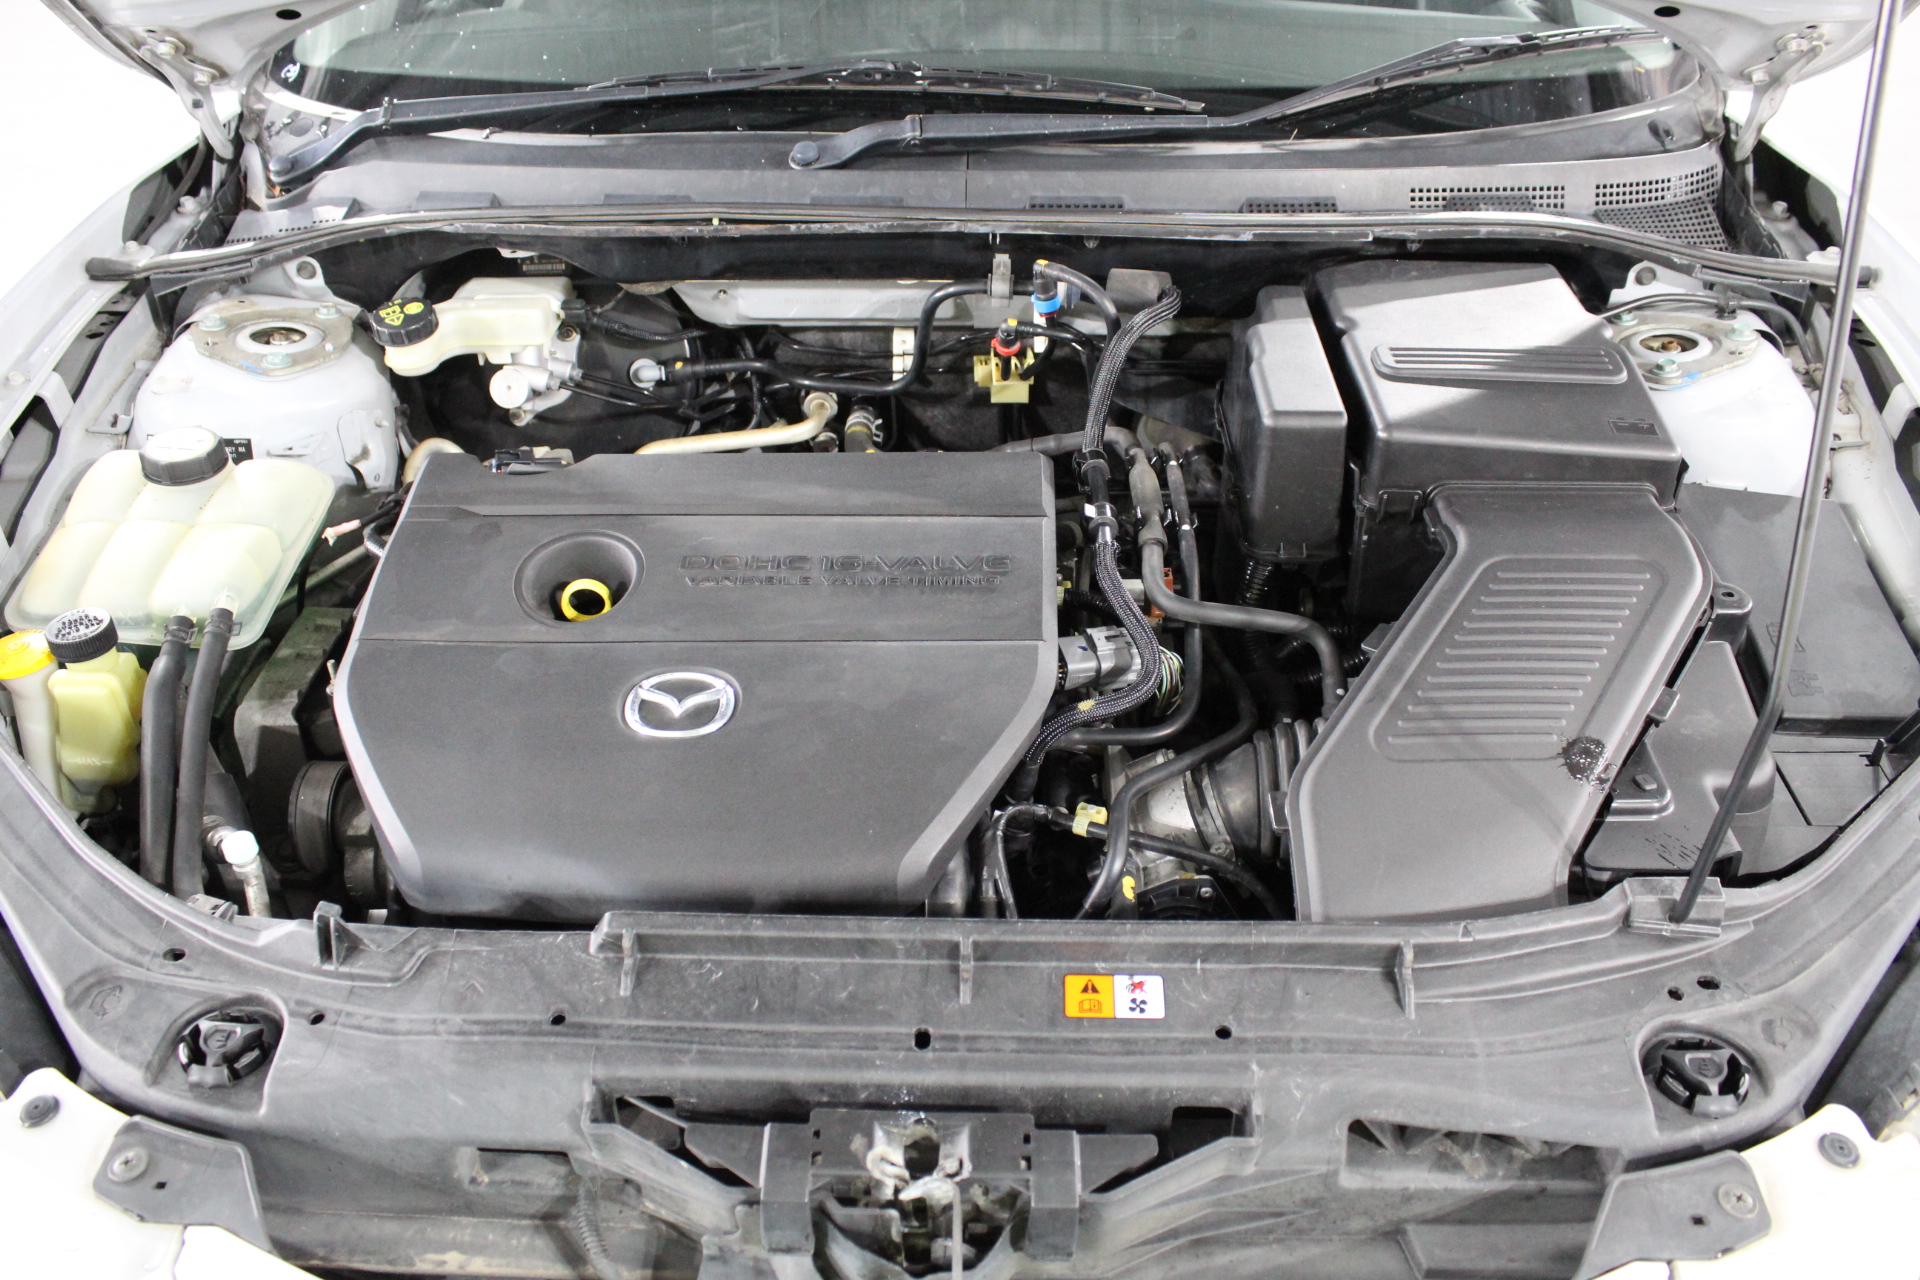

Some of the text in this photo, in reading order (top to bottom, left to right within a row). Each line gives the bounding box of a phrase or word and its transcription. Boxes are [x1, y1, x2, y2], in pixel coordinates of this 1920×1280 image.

[679, 555, 1010, 572] DOHC 16-VALVE
[685, 576, 1001, 586] VARIABLE VALVE TIMING
